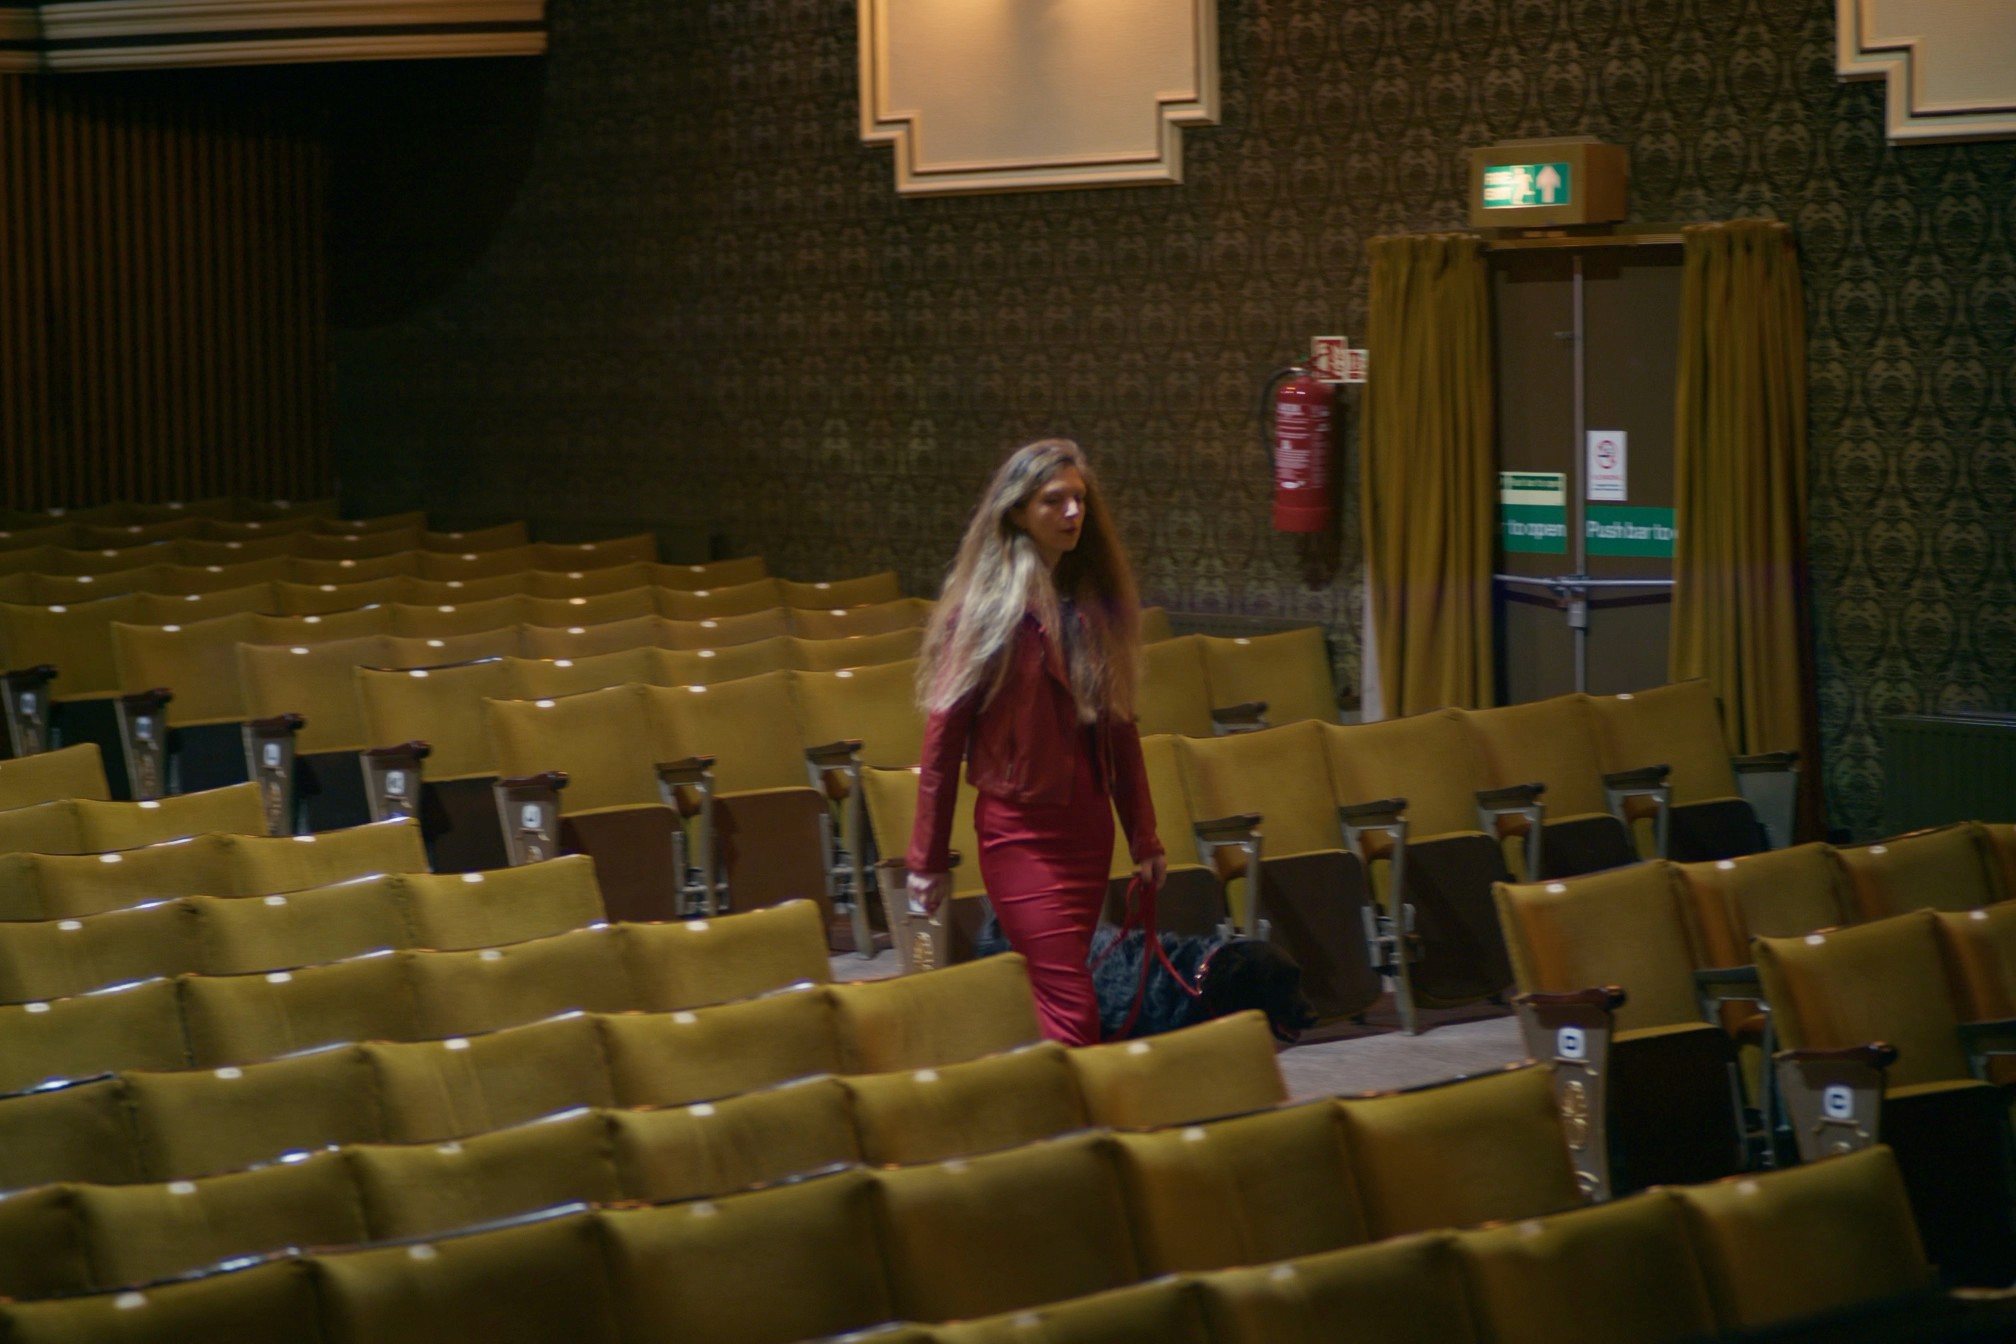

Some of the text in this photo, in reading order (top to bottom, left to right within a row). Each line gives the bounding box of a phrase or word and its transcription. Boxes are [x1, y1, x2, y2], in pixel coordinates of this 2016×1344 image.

[1507, 519, 1526, 536] to
[1526, 522, 1567, 540] open
[1585, 520, 1622, 538] Push
[1623, 521, 1652, 540] bar
[1653, 523, 1673, 541] to
